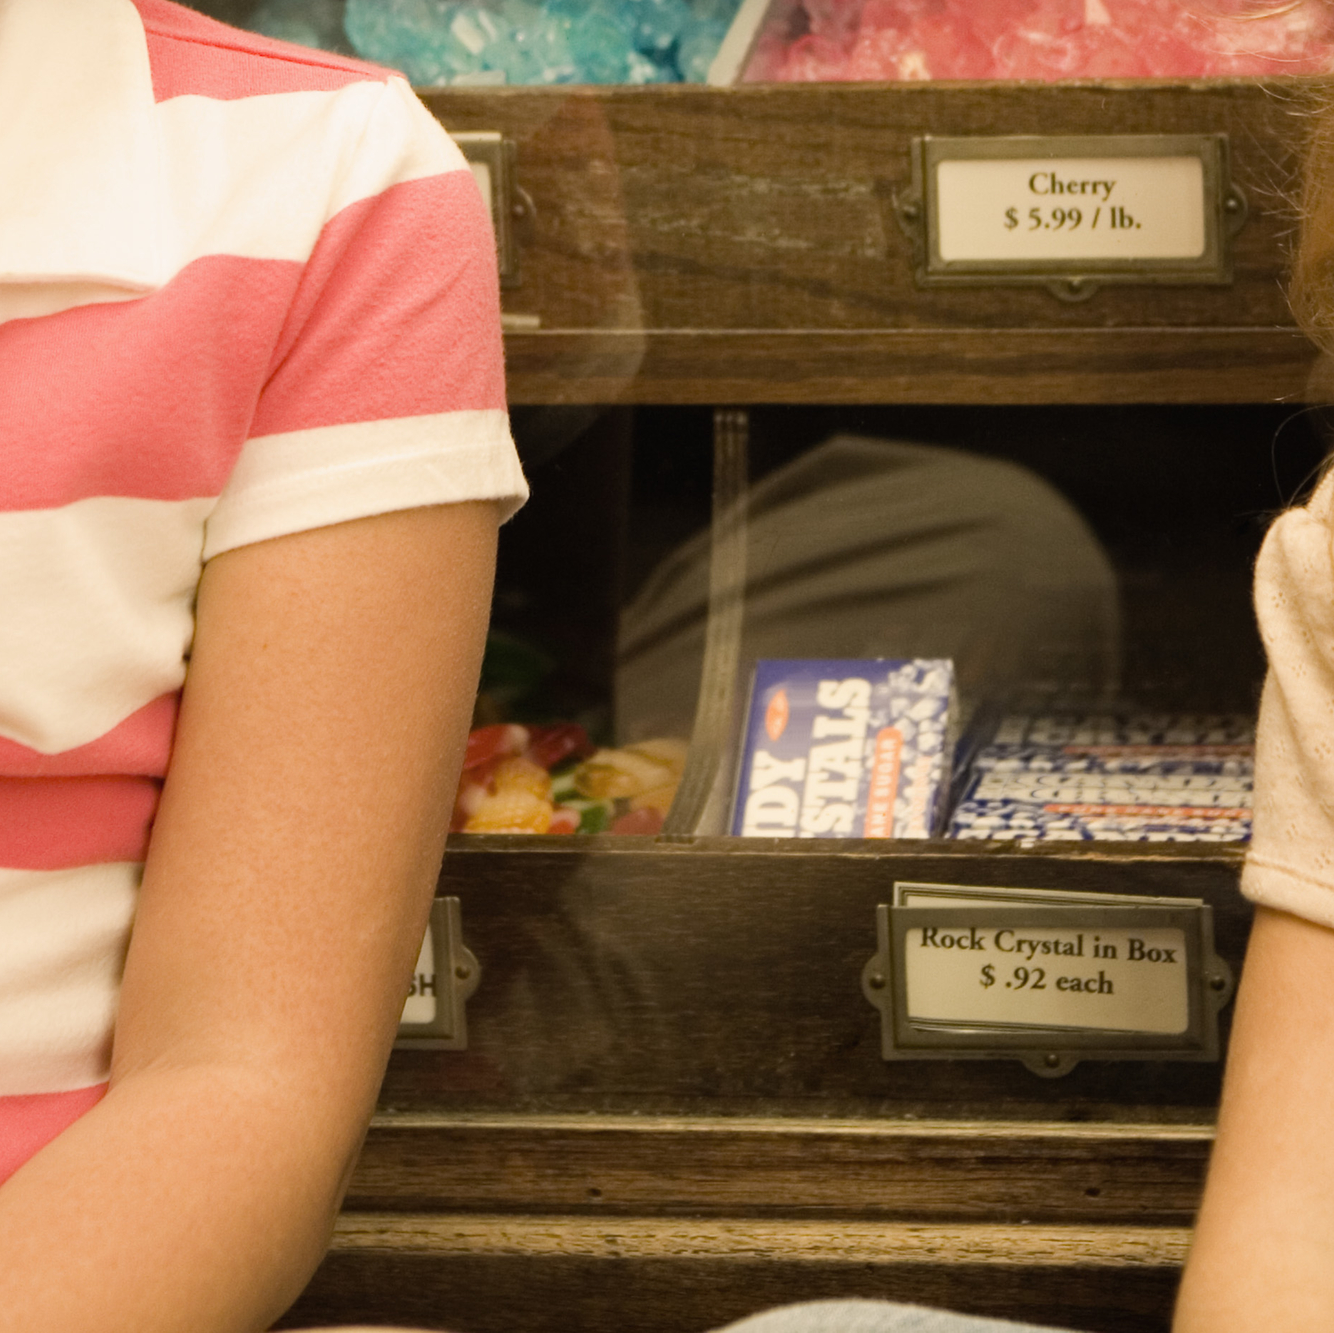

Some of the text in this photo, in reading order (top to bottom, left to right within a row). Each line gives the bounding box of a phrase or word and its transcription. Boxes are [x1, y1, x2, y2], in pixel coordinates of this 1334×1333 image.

[1028, 172, 1117, 202] Cherry
[1004, 206, 1142, 232] $ 5.99 / lb.
[798, 677, 873, 838] STALS
[872, 736, 899, 799] SUGAR
[741, 749, 806, 838] DY
[920, 926, 1179, 964] Rock Crystal in Box
[980, 964, 1115, 995] $ .92 each
